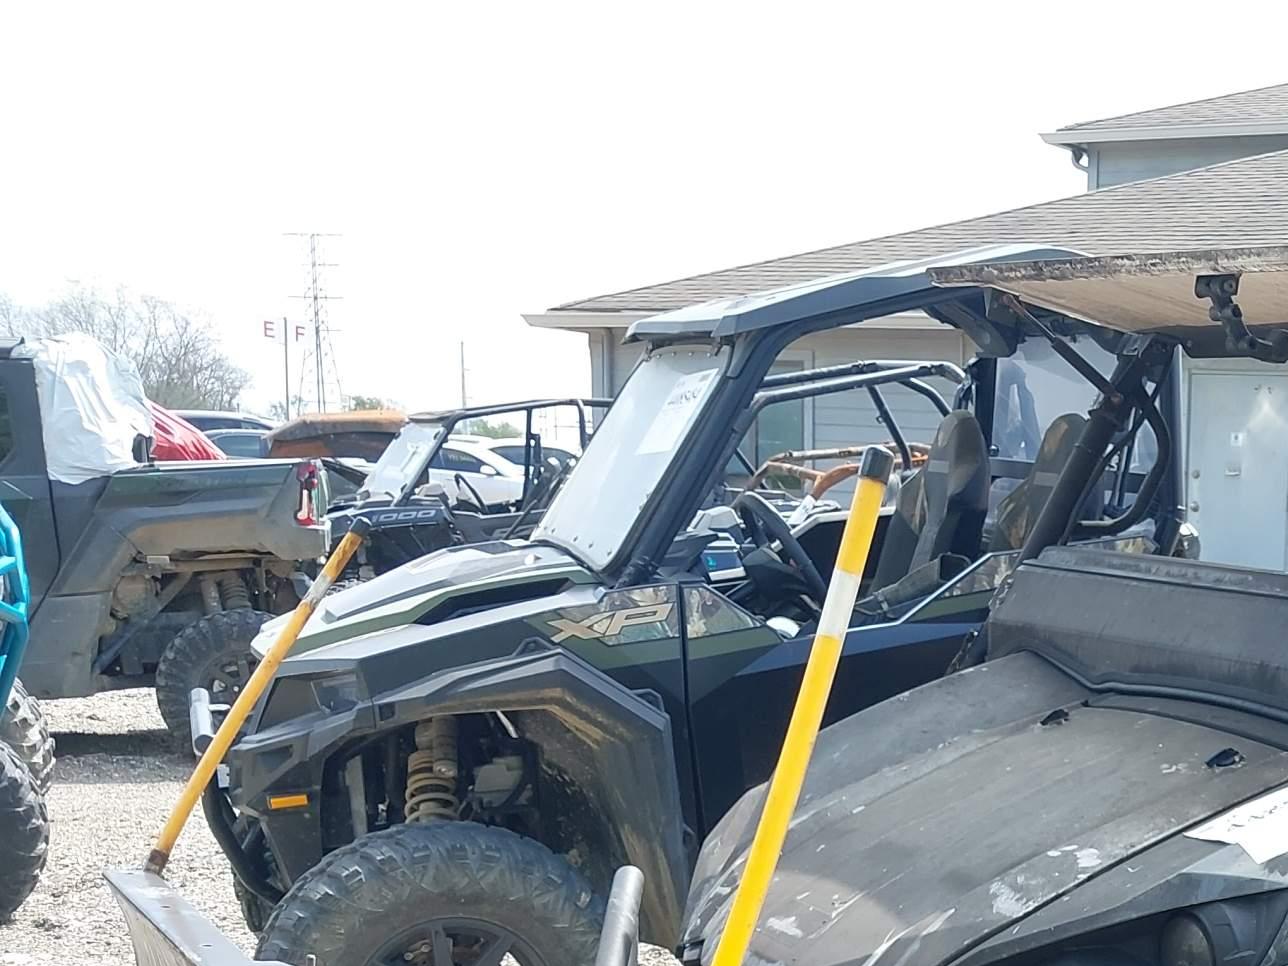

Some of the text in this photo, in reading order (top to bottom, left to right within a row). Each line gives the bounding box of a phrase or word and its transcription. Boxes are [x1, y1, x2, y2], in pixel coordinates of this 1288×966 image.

[263, 320, 275, 338] E
[295, 325, 305, 342] F
[546, 602, 674, 643] XP
